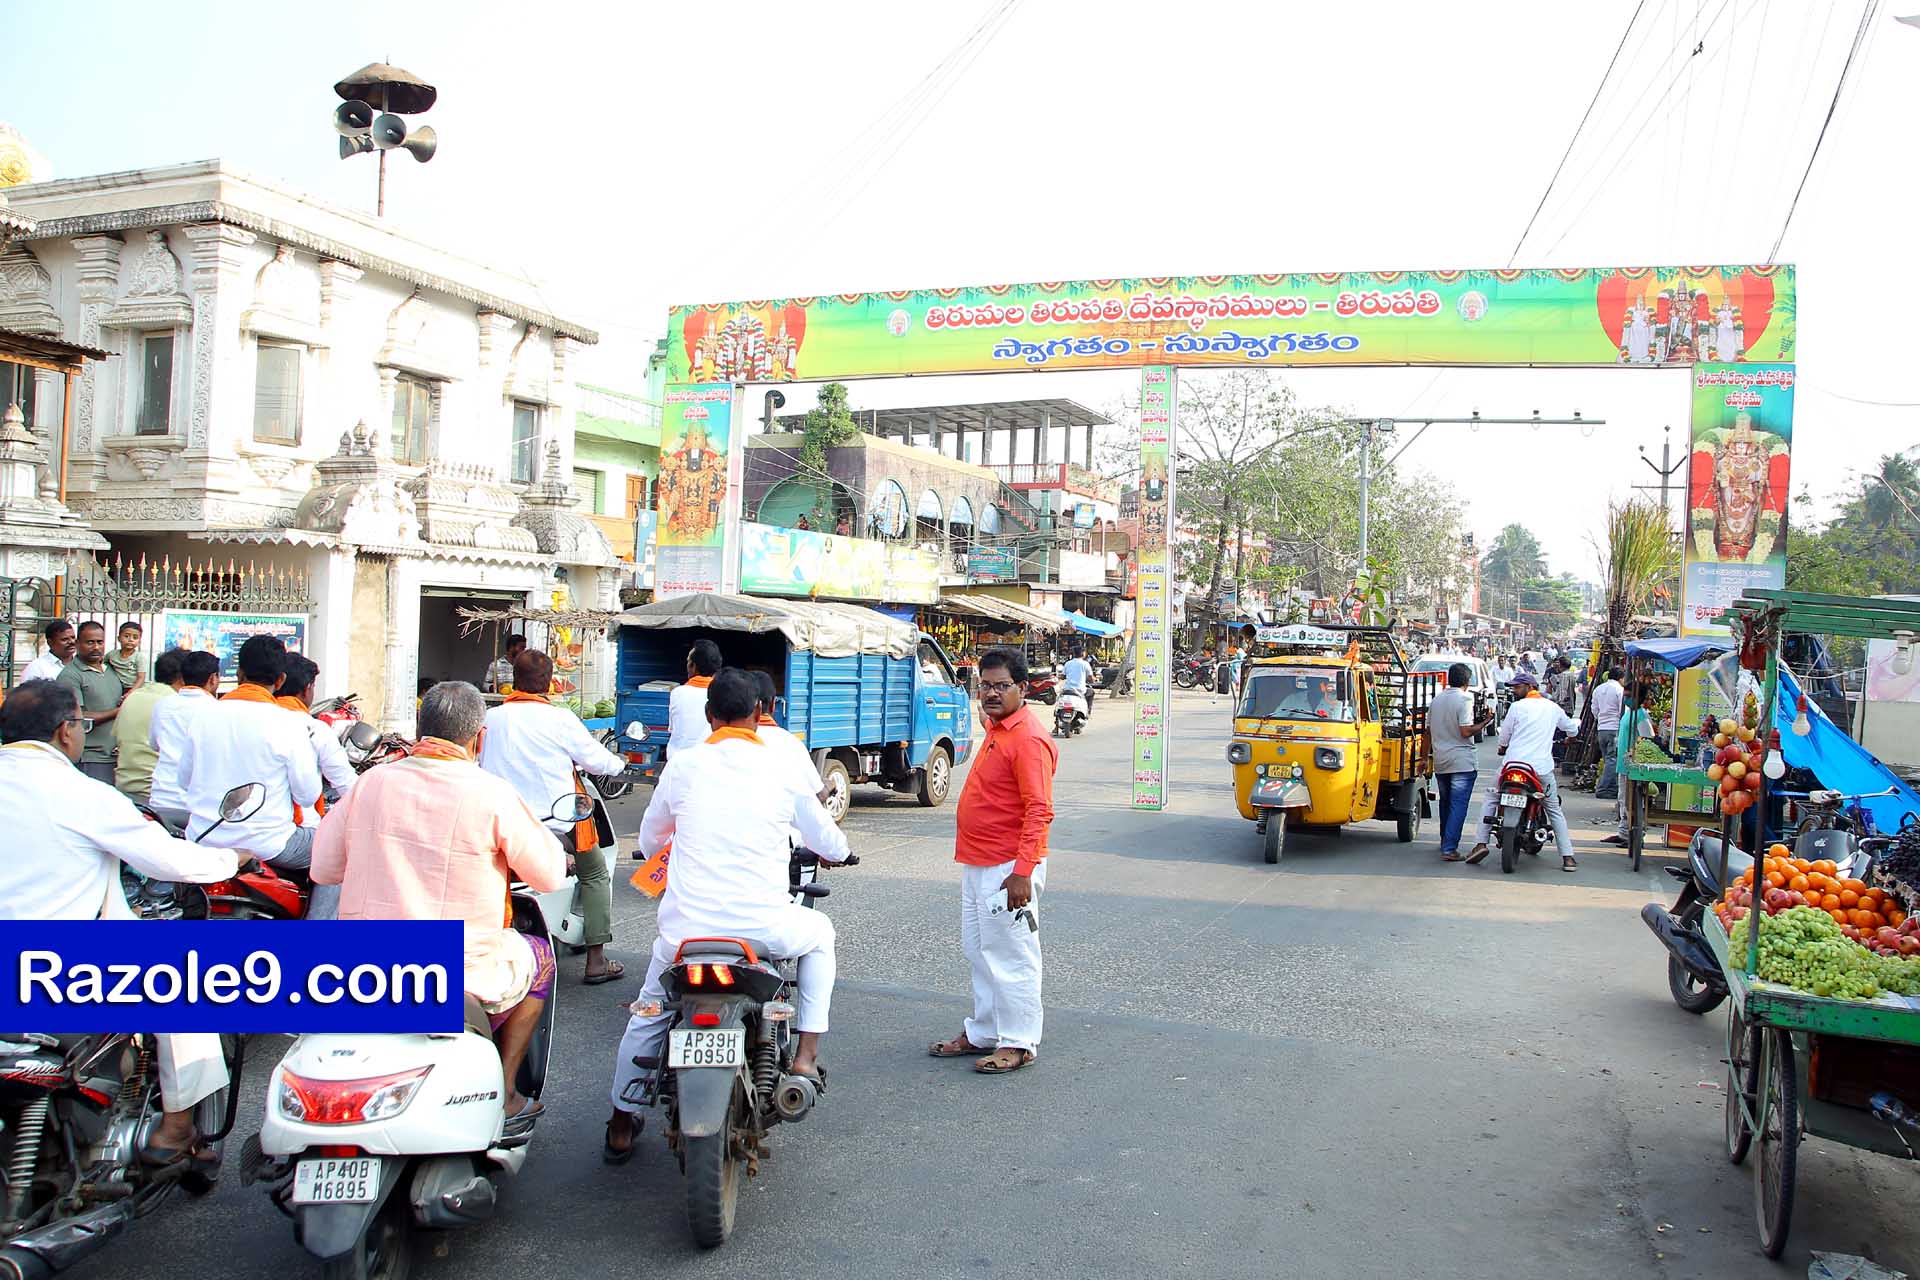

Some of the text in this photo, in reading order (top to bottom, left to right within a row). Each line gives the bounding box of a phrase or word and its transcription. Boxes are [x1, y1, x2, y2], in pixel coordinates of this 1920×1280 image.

[927, 305, 1024, 328] తిరుమల
[1031, 300, 1123, 323] తిరుపతి
[1129, 293, 1306, 329] దేవస్థానములు
[1337, 292, 1439, 316] తిరుపతి
[994, 336, 1129, 363] స్వాగతం
[1165, 331, 1359, 358] సుస్వాగతం
[684, 1032, 736, 1048] AP39H
[683, 1049, 736, 1065] F0950
[315, 1160, 369, 1180] AP40B
[313, 1181, 366, 1200] M6895
